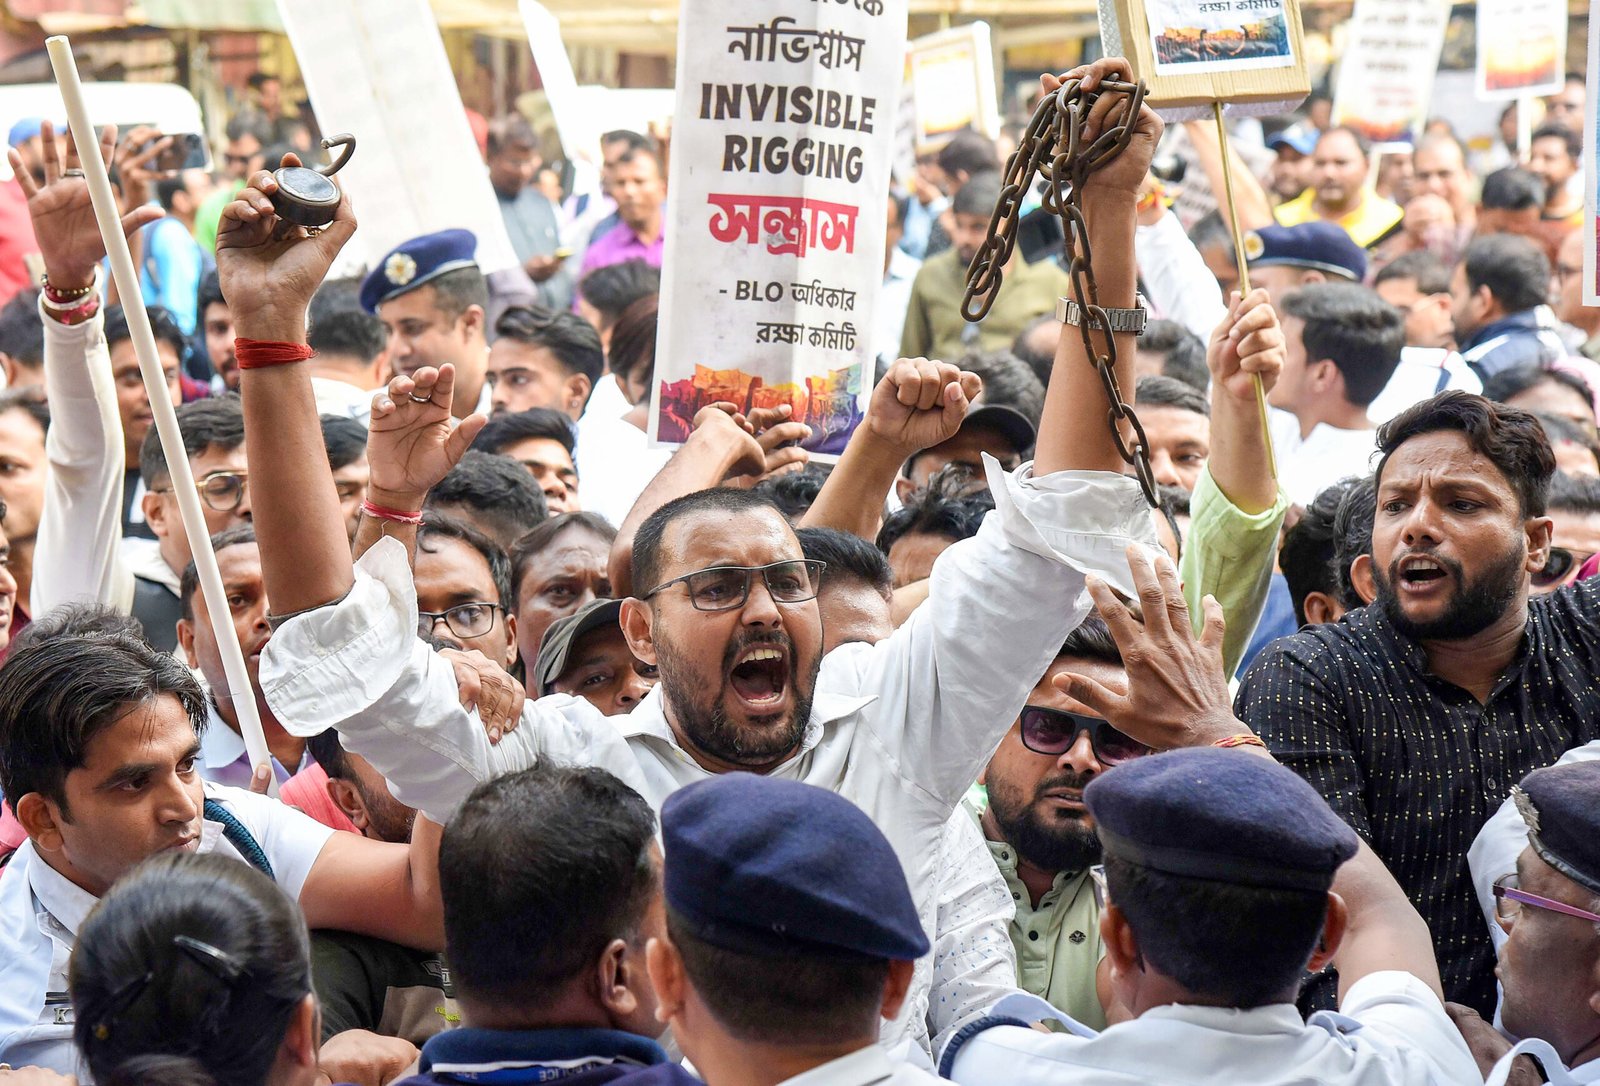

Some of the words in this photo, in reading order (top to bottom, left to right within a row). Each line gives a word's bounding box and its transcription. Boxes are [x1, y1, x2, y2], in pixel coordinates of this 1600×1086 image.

[727, 17, 866, 72] নাভিশ্বাস
[700, 83, 877, 134] INVISIBLE
[722, 134, 864, 184] RIGGING
[707, 193, 860, 258] সন্ত্রাস
[735, 280, 784, 303] BLO
[790, 279, 857, 312] অধিকার
[808, 322, 857, 351] কমিটি
